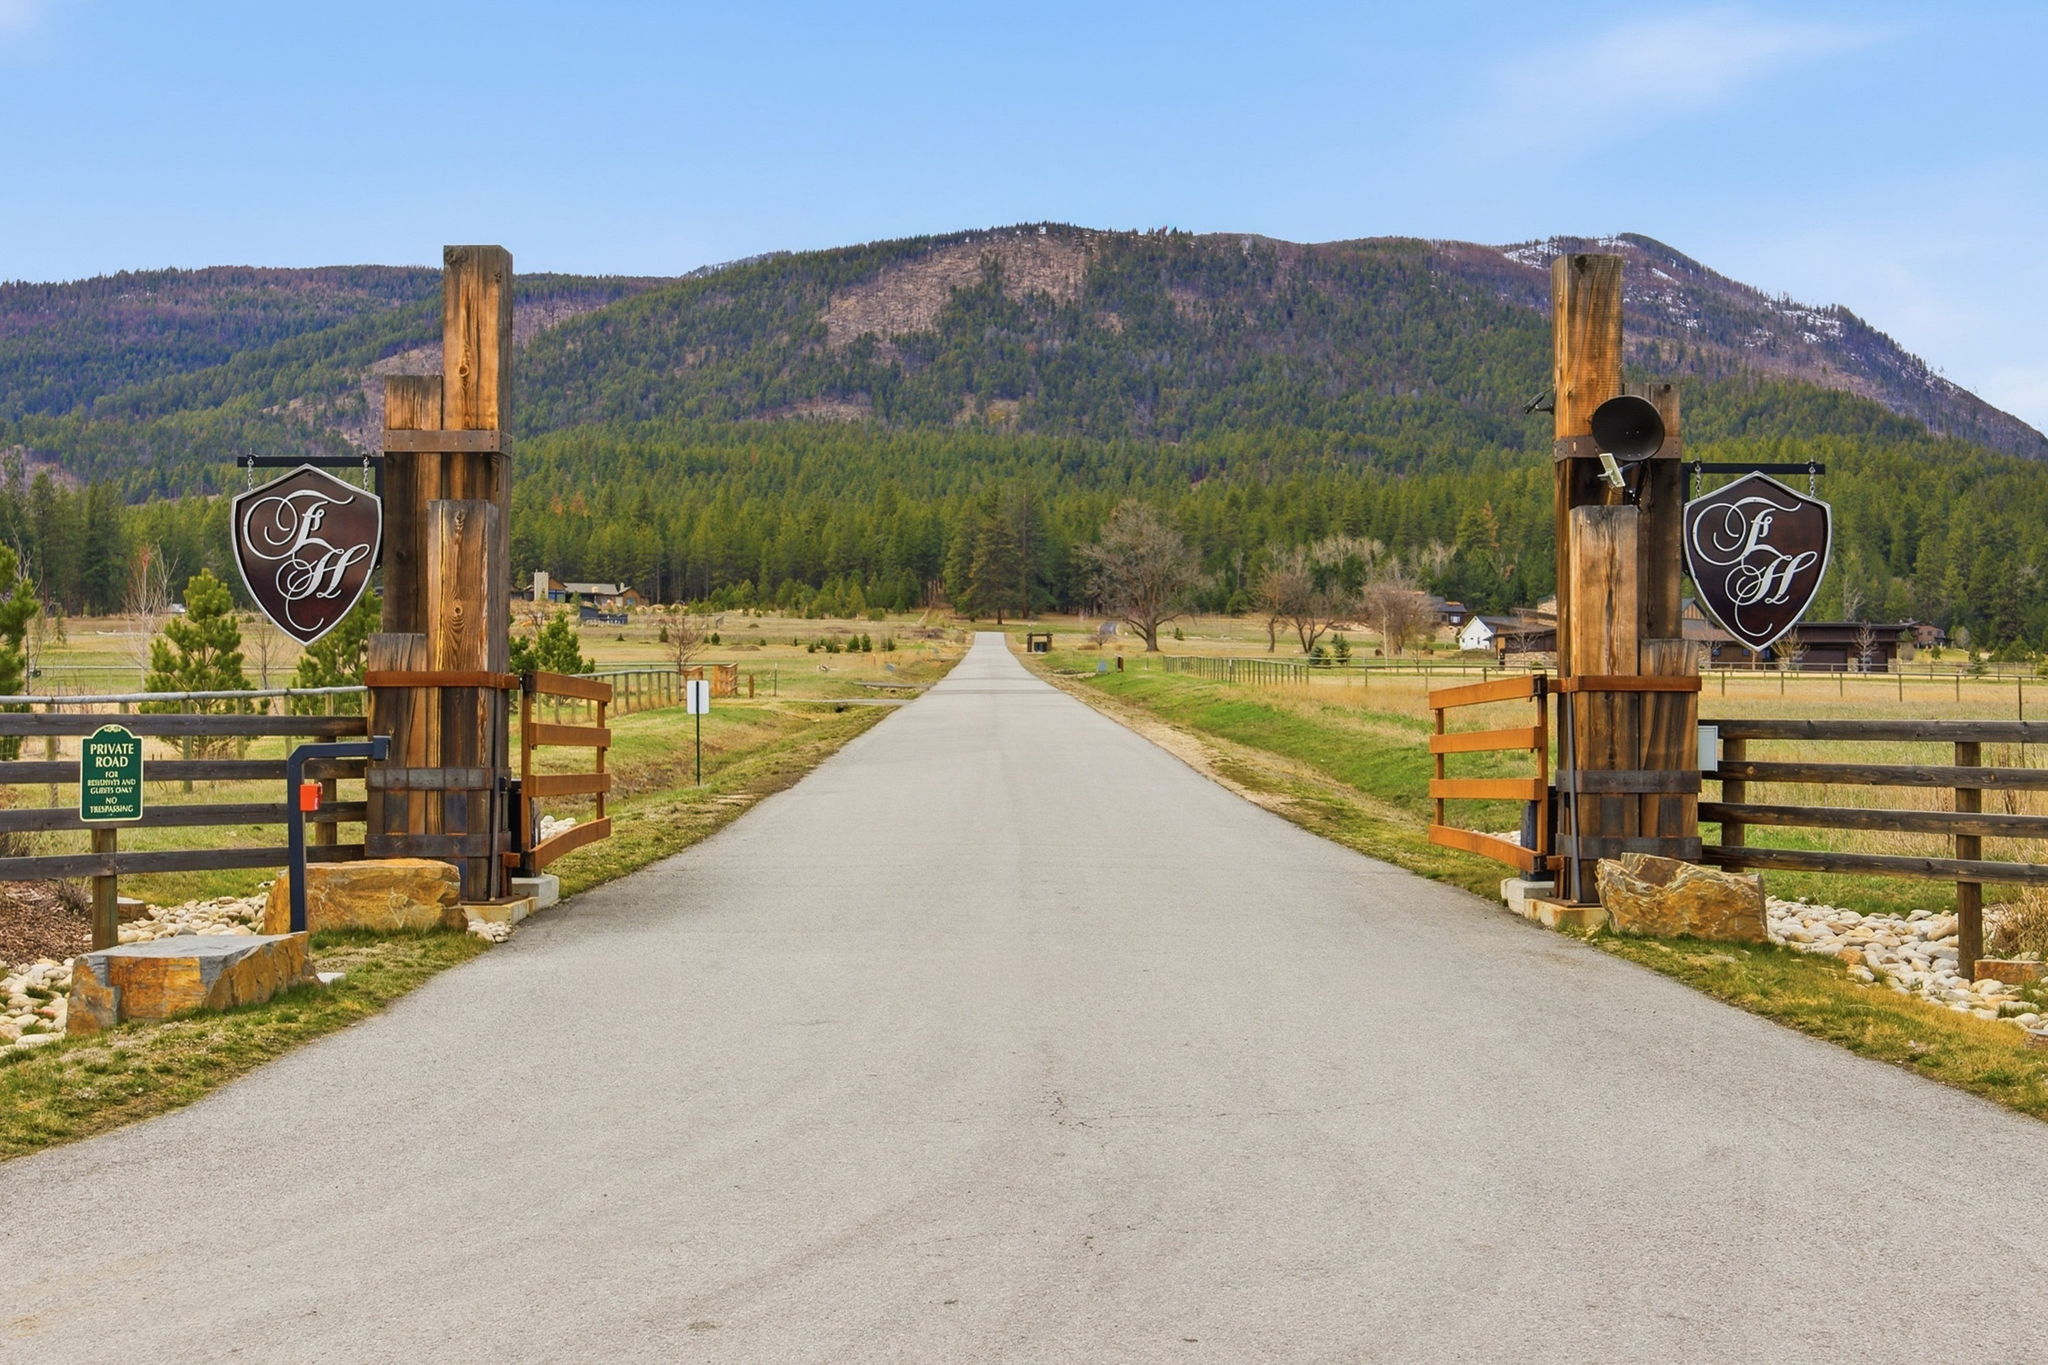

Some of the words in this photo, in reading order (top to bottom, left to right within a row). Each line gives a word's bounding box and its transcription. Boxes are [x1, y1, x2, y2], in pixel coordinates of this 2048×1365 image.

[90, 743, 134, 755] PRIVATE
[96, 756, 128, 768] ROAD
[90, 805, 134, 813] TRESPASSING
